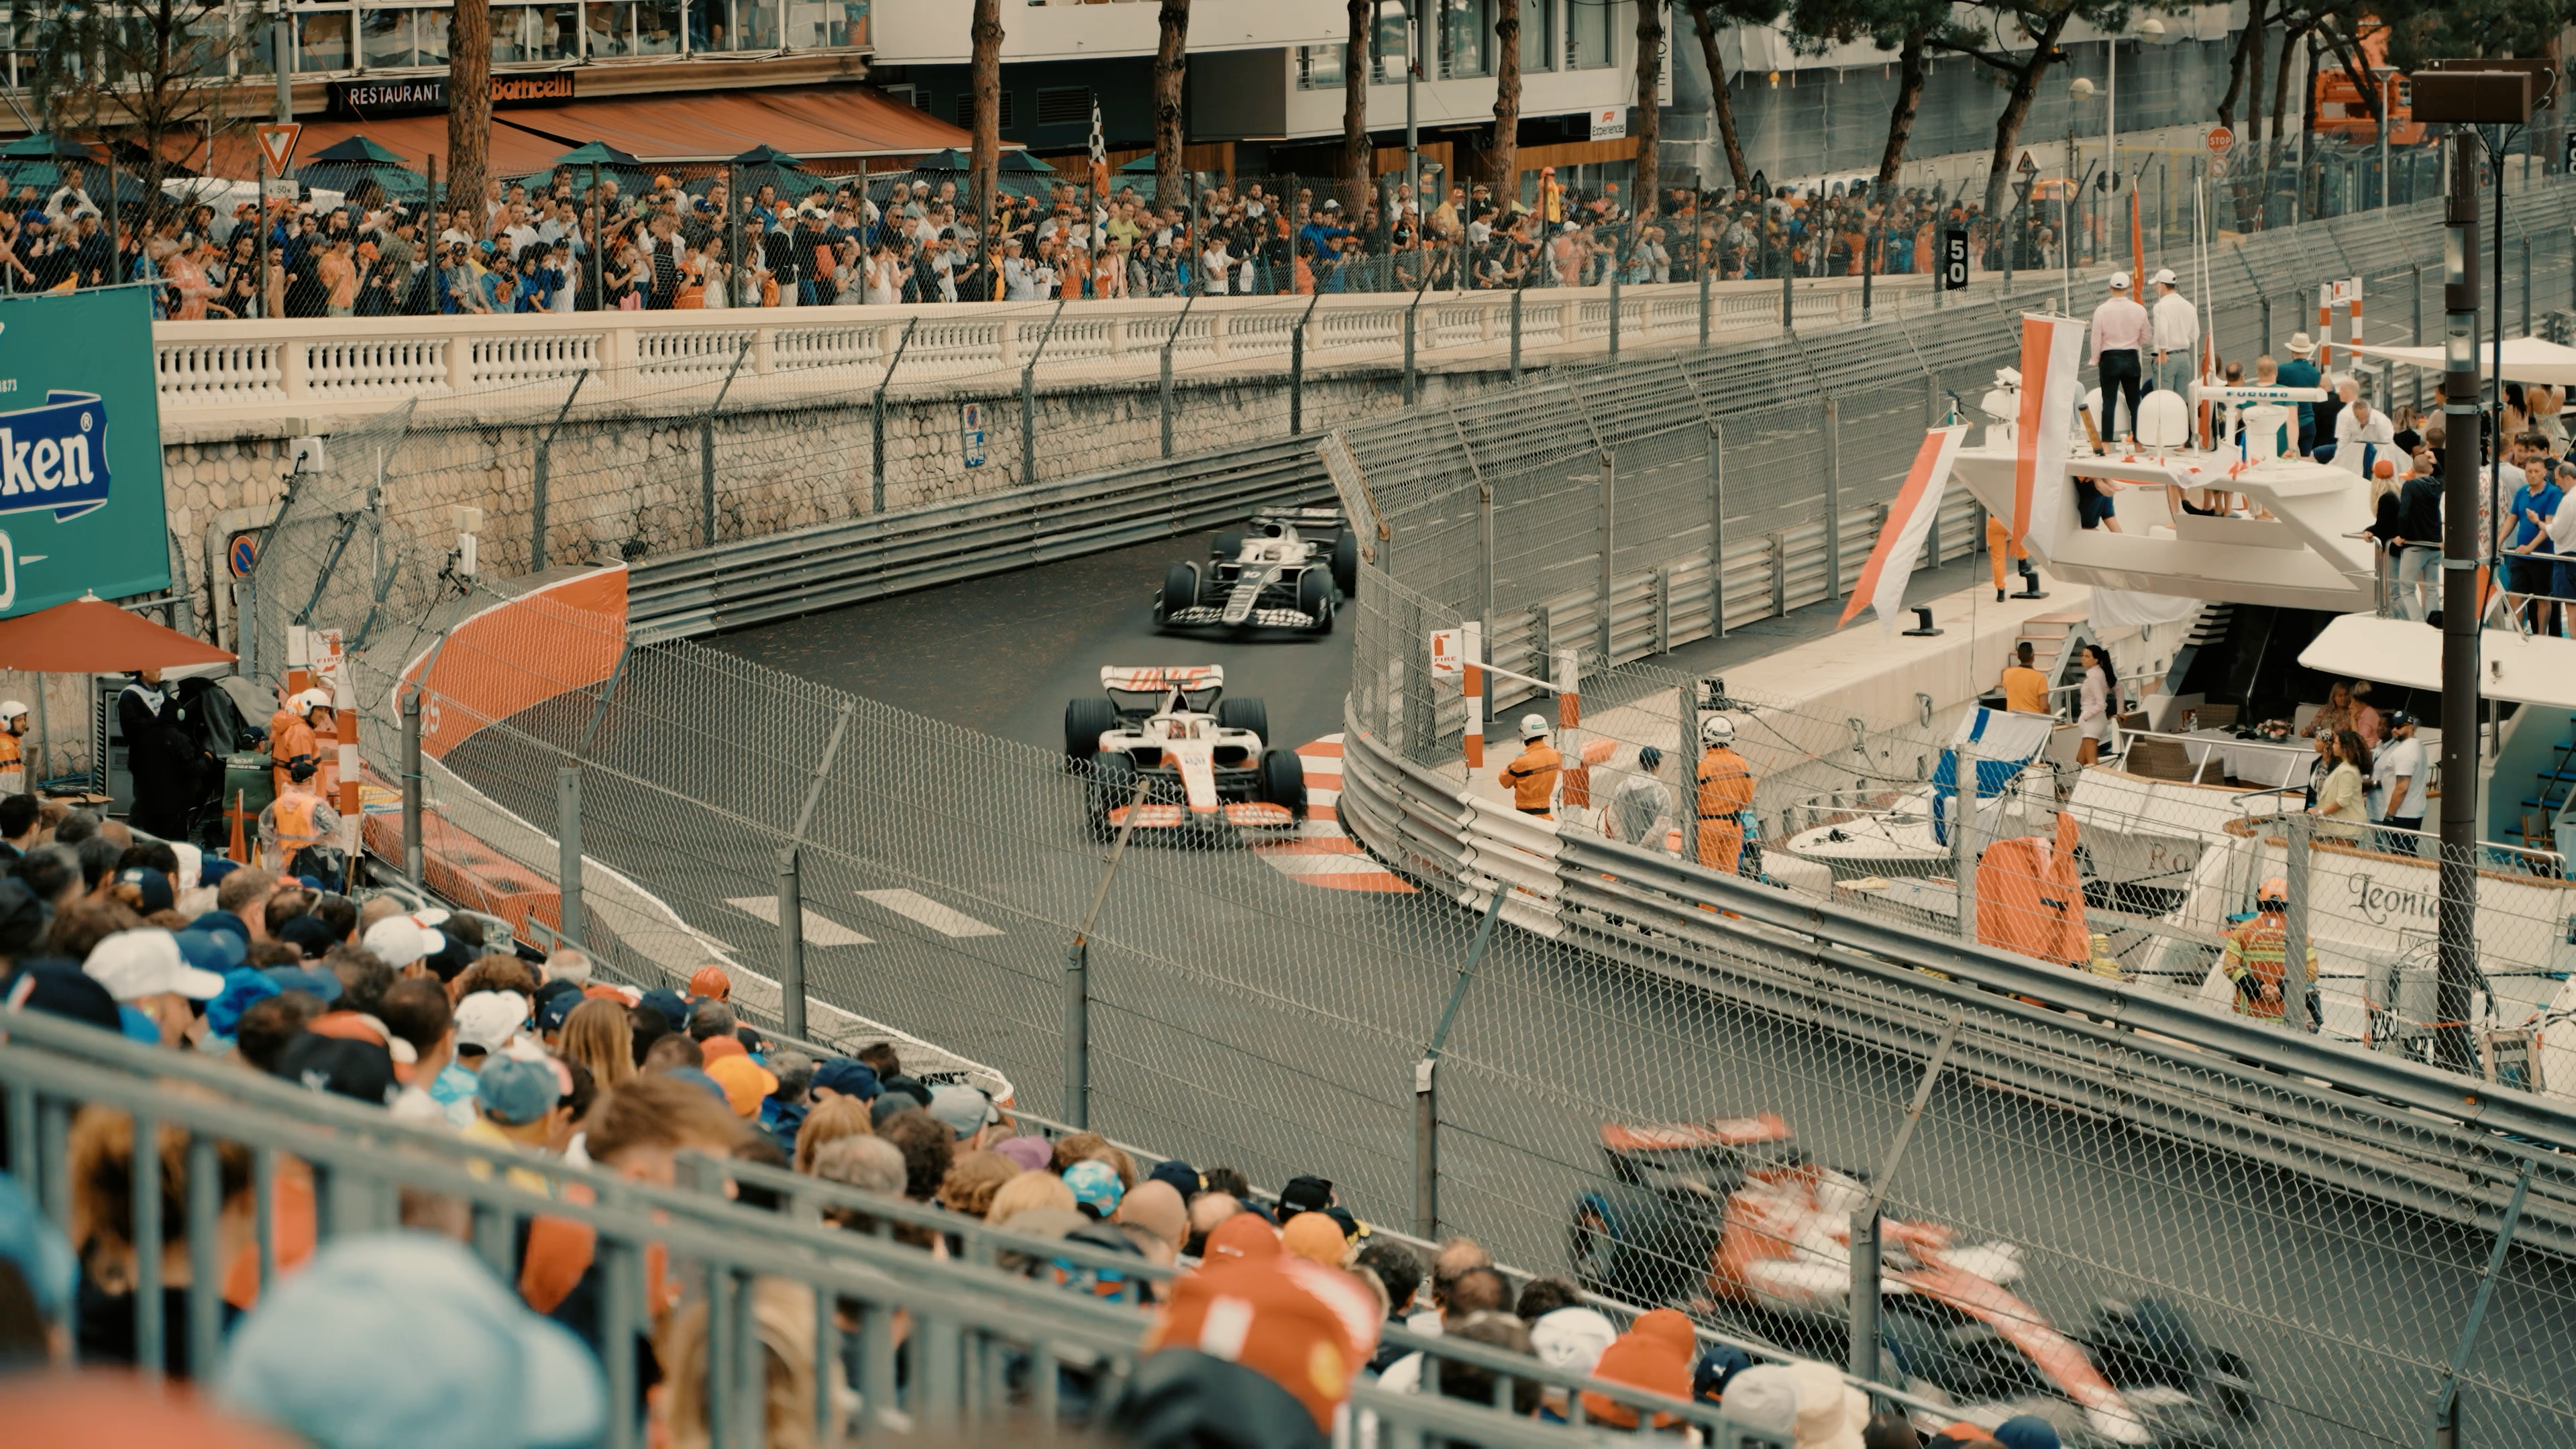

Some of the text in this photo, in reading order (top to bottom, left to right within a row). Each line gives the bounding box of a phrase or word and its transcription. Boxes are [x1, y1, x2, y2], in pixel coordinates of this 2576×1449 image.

[350, 74, 573, 105] RESTAURANT Botticelli
[1592, 124, 1625, 137] Experiences
[2210, 137, 2231, 146] STOP
[1950, 239, 1965, 282] 50
[0, 427, 94, 495] ken
[316, 656, 341, 664] FIRE
